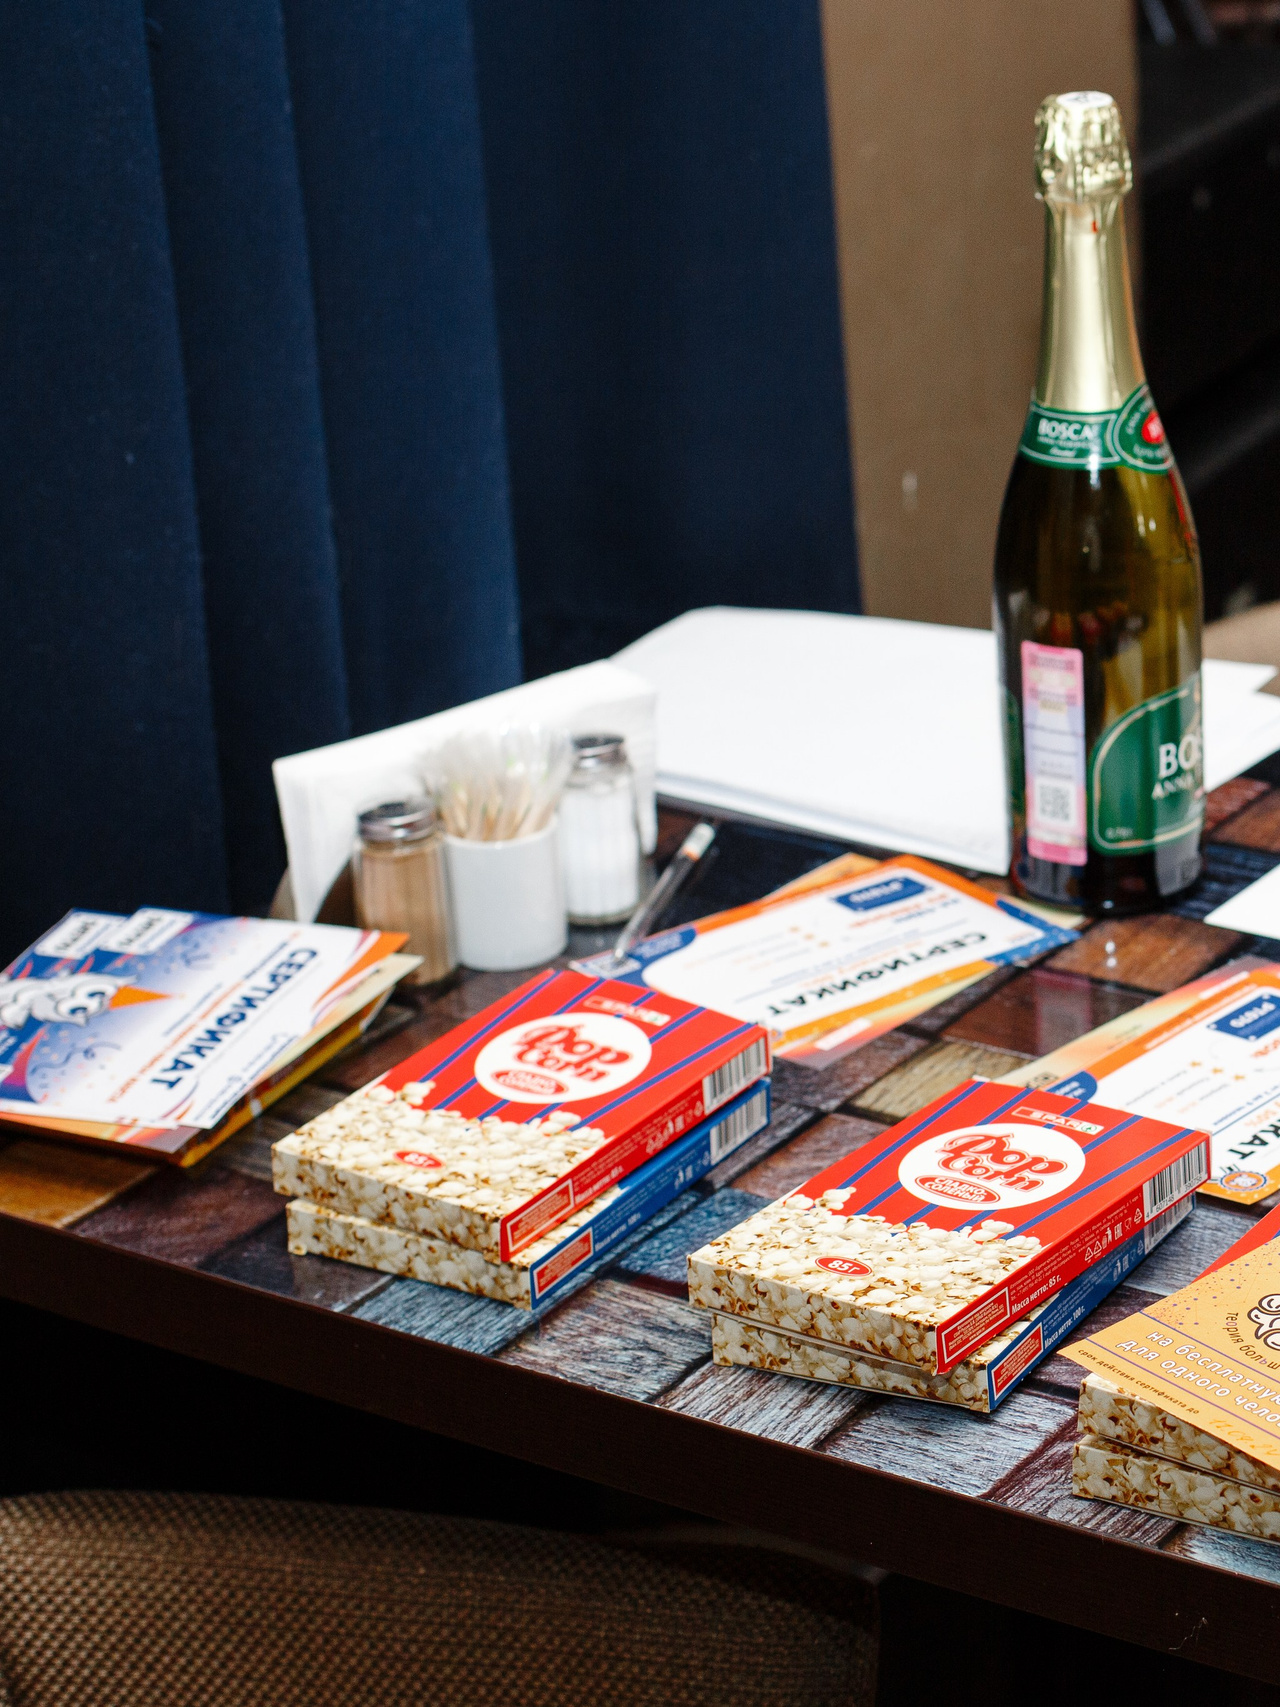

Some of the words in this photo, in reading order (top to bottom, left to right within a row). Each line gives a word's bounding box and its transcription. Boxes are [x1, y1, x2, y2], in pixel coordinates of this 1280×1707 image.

[766, 931, 988, 1017] СЕРТИФИКАТ
[150, 948, 318, 1090] СЕРТИФИКАТ
[512, 1022, 632, 1066] Pop
[1028, 1110, 1084, 1129] SPAR
[936, 1132, 1068, 1177] Pop
[938, 1154, 1045, 1193] Corn
[827, 1258, 860, 1276] 85г
[1011, 1296, 1031, 1315] Масса
[1029, 1284, 1049, 1302] нетто:
[1048, 1278, 1057, 1289] 85
[1044, 1329, 1059, 1350] Масса
[1072, 1309, 1082, 1322] 100
[1145, 1330, 1175, 1348] на
[1222, 1311, 1245, 1346] теория
[1077, 1347, 1097, 1363] срок
[1096, 1358, 1136, 1382] действия
[1134, 1378, 1188, 1409] сертификата
[1187, 1406, 1201, 1416] до
[1115, 1338, 1162, 1363] для
[1159, 1358, 1234, 1399] одного
